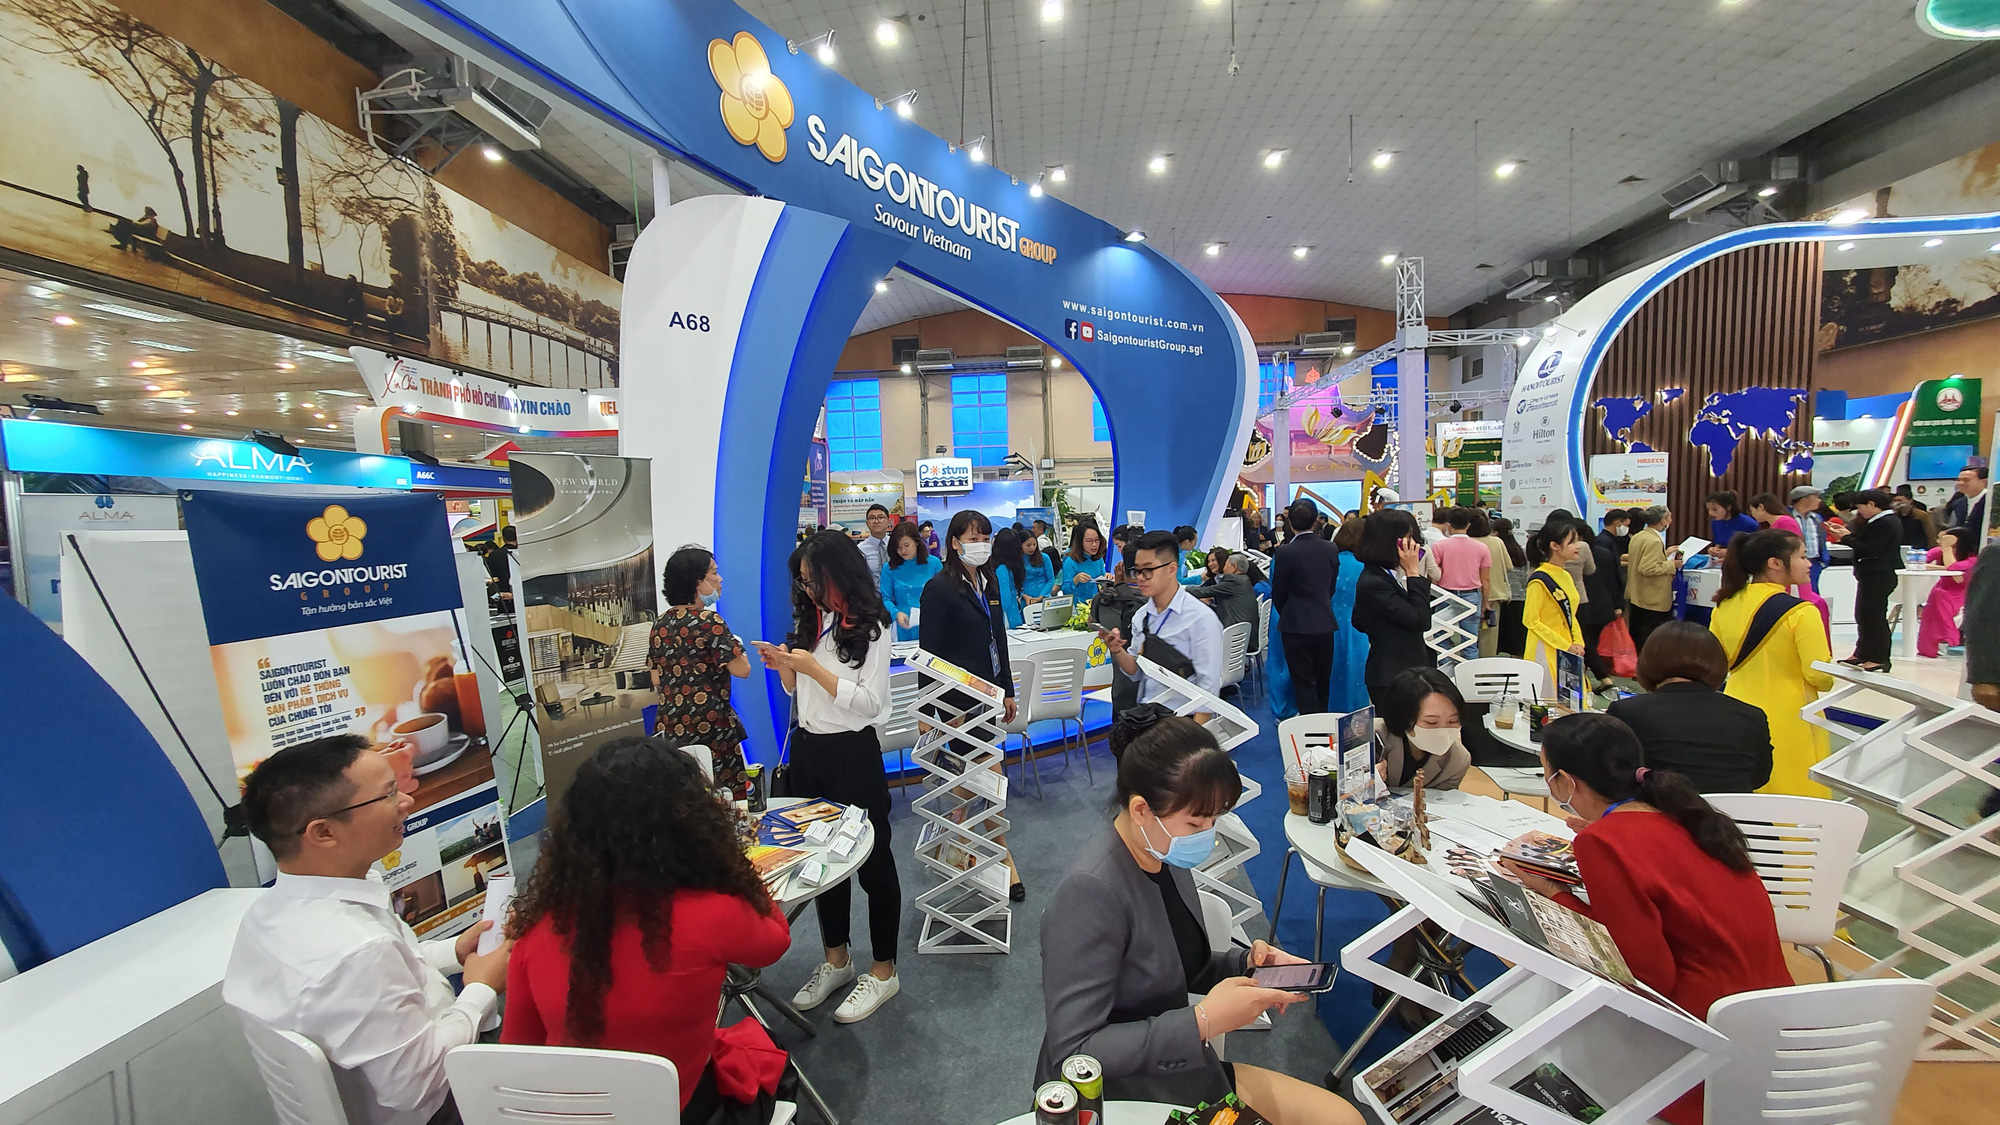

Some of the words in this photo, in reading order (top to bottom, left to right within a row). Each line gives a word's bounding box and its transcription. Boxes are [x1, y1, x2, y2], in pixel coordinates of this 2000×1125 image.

[807, 114, 1020, 252] SAIGONTOURIST
[1019, 237, 1057, 265] GROUP
[874, 203, 920, 239] Savour
[923, 224, 972, 260] Vietnam
[669, 311, 711, 333] A68
[1062, 300, 1205, 333] www.saigontourist.com.vn
[1097, 330, 1204, 356] SaigontouristGroup.sgt
[420, 377, 453, 400] THÀNH
[453, 382, 471, 403] PHỐ
[472, 385, 483, 406] HỒ
[484, 391, 497, 408] CHÍ
[497, 394, 519, 414] MINH
[519, 398, 538, 415] XIN
[540, 399, 571, 416] CHÀO
[1533, 429, 1555, 439] Hilton
[190, 442, 314, 474] ALMA
[416, 471, 434, 480] A66C
[555, 477, 576, 486] NEW
[1519, 477, 1552, 486] pullman
[79, 511, 135, 520] ALMA
[269, 563, 408, 591] SAIGONTOURIST
[300, 583, 389, 600] GROUP
[301, 606, 317, 616] Tận
[347, 601, 363, 610] bản
[364, 598, 378, 608] sắc
[378, 597, 393, 606] Việt
[259, 659, 327, 680] SAIGONTOURIST
[261, 678, 285, 692] LUÔN
[314, 670, 331, 681] ĐÓN
[333, 666, 350, 677] BẠN
[263, 690, 282, 703] ĐẾN
[284, 687, 298, 699] VỚI
[300, 684, 312, 696] HỆ
[314, 679, 342, 692] THỐNG
[288, 696, 314, 711] PHẨM
[317, 692, 336, 705] DỊCH
[338, 688, 349, 699] VỤ
[268, 714, 287, 728] CỦA
[288, 707, 318, 723] CHÚNG
[319, 703, 332, 715] TÔI
[406, 817, 429, 832] GROUP
